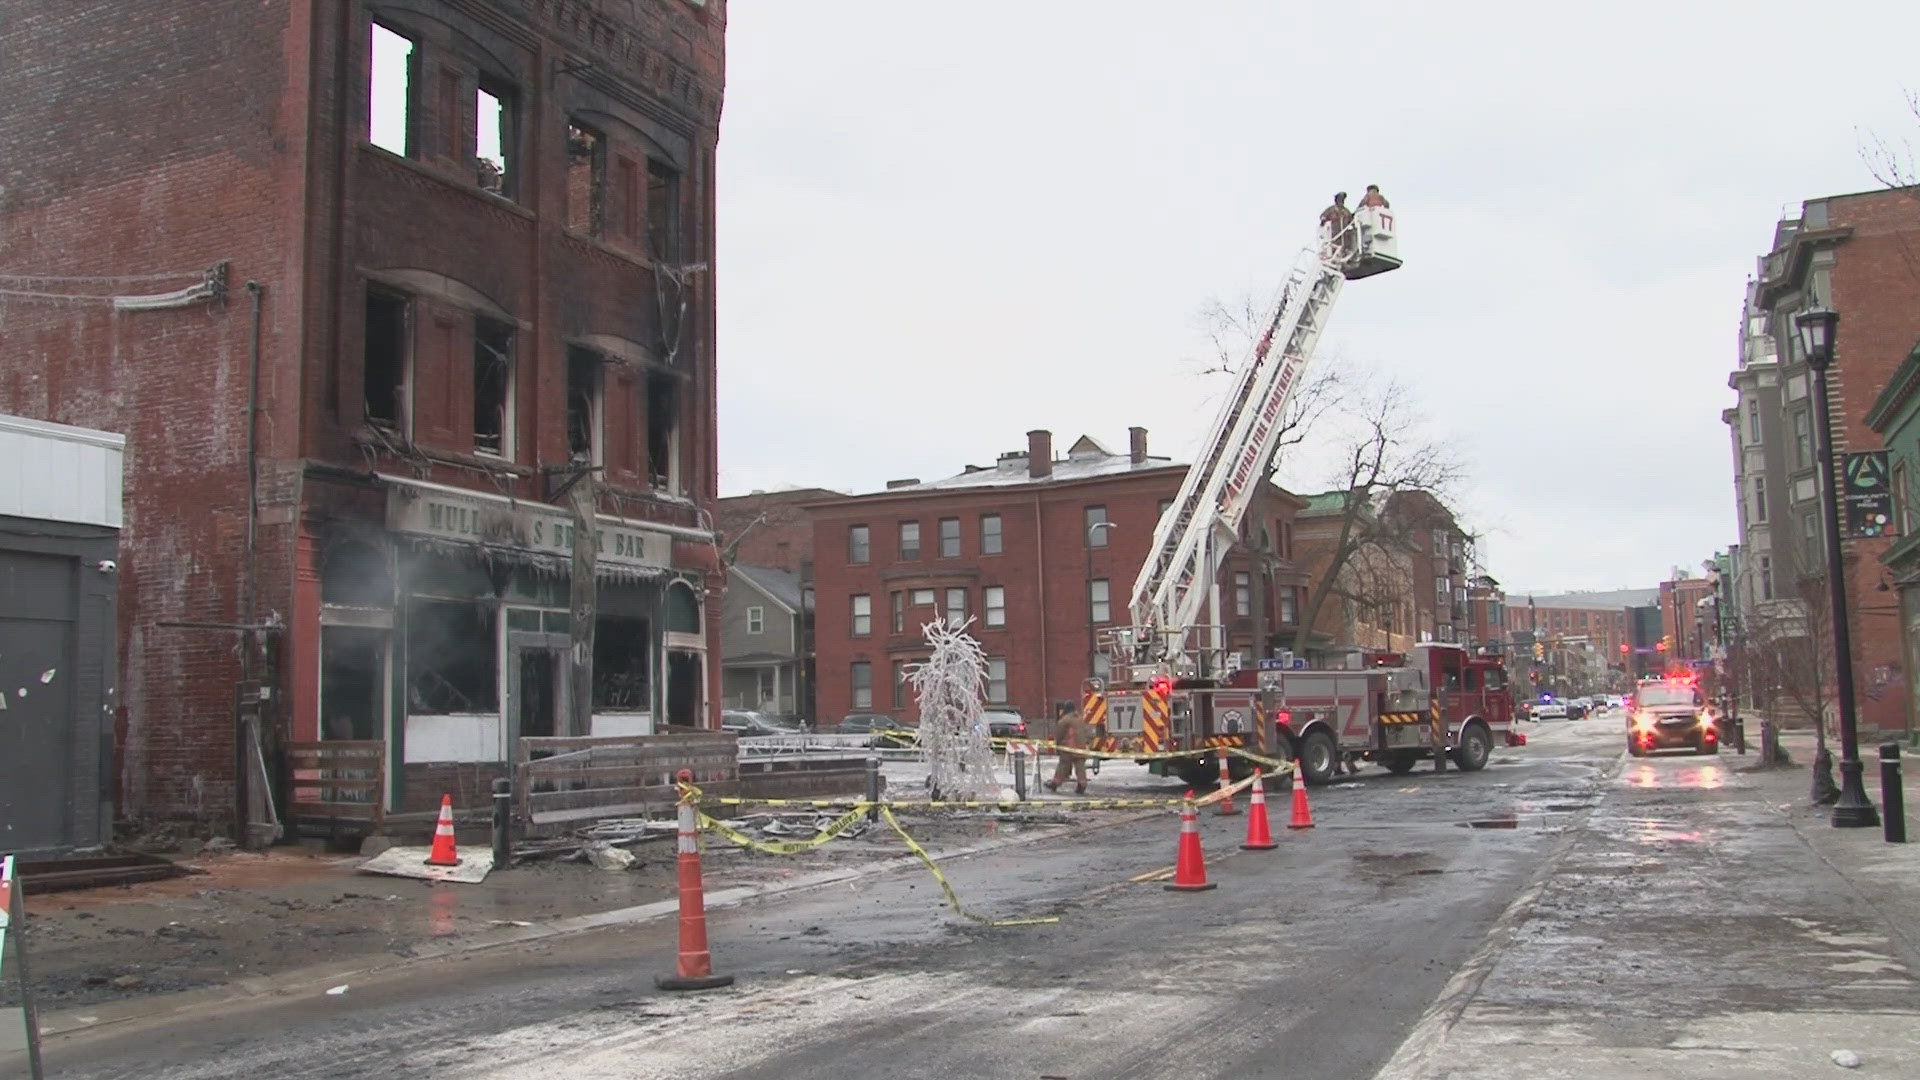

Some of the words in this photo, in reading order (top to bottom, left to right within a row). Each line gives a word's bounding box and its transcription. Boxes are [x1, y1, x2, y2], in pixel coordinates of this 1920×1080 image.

[1379, 213, 1393, 231] T7
[1232, 444, 1258, 490] BUFFALO
[1252, 421, 1269, 447] FIRE
[1262, 363, 1296, 424] DEPARTMENT
[553, 523, 604, 552] BRK
[615, 533, 644, 559] BAR
[1113, 706, 1137, 730] T7
